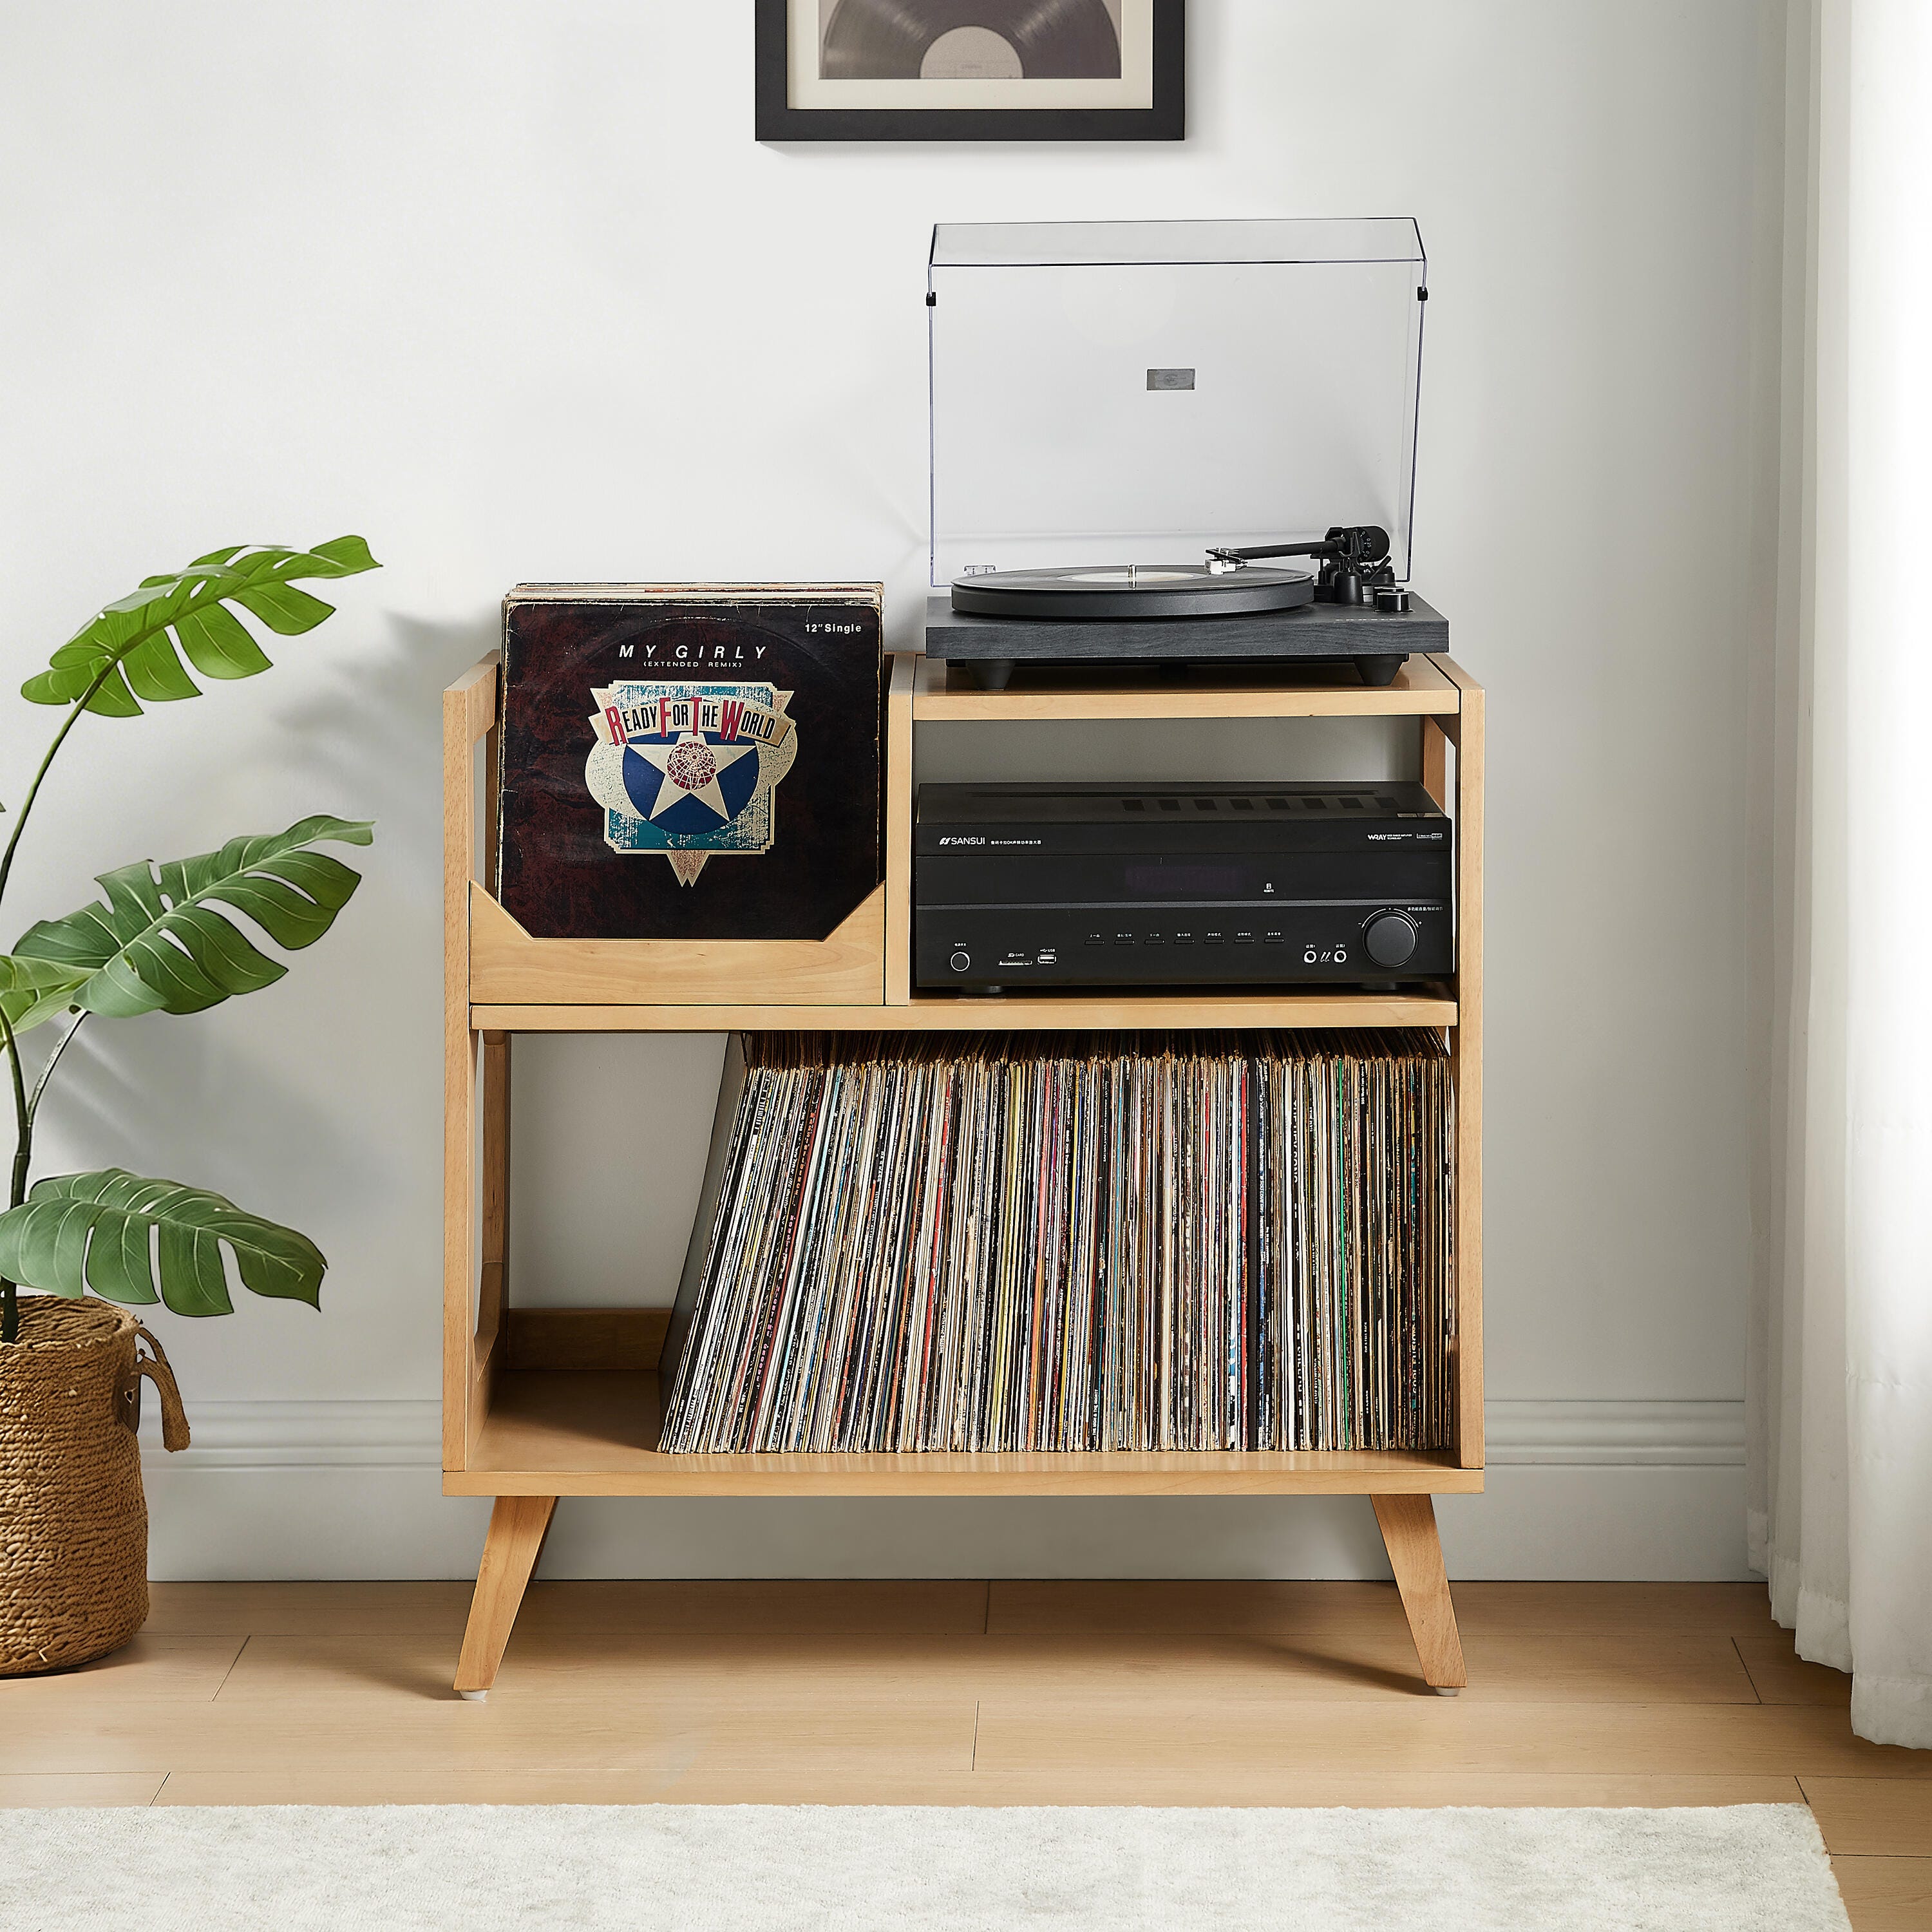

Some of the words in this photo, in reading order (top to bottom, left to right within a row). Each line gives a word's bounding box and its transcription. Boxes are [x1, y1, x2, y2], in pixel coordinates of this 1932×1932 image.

[619, 645, 656, 658] MY
[676, 645, 766, 659] GIRLY
[605, 704, 658, 746] READY
[659, 697, 689, 738] FOR
[690, 697, 719, 736] THE
[720, 699, 775, 741] WORLD
